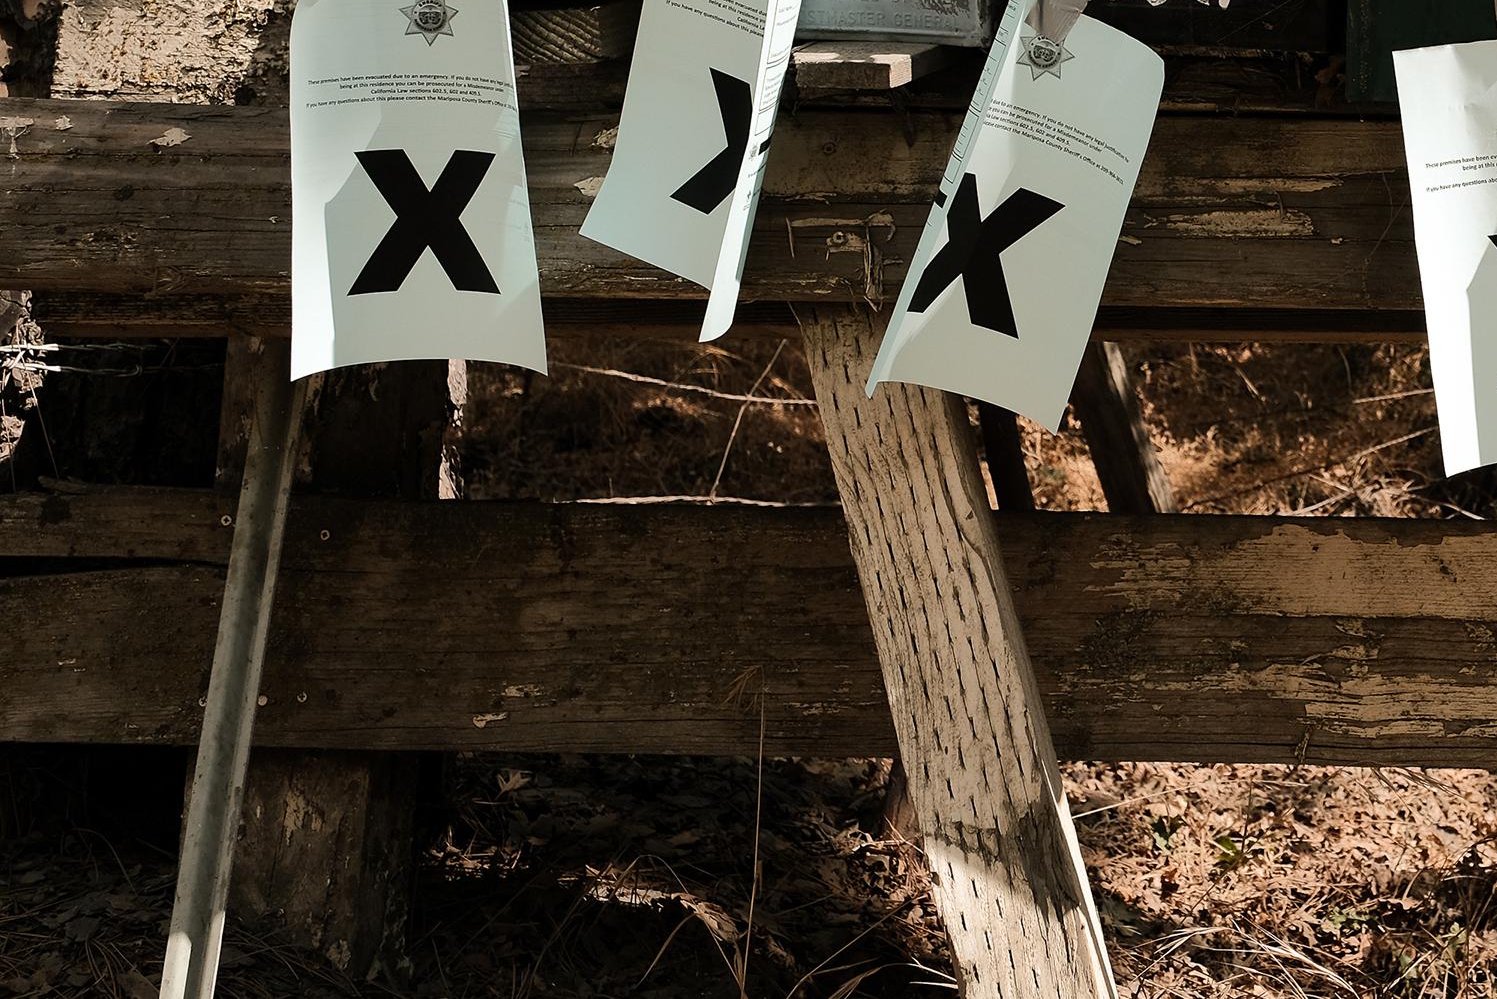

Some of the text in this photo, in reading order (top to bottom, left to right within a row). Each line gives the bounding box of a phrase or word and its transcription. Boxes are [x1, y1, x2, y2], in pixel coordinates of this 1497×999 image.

[735, 2, 758, 13] evacuated
[807, 10, 886, 26] STMASTER
[1046, 131, 1055, 140] and
[1462, 179, 1488, 187] questions
[347, 149, 501, 296] X
[907, 172, 1066, 340] X
